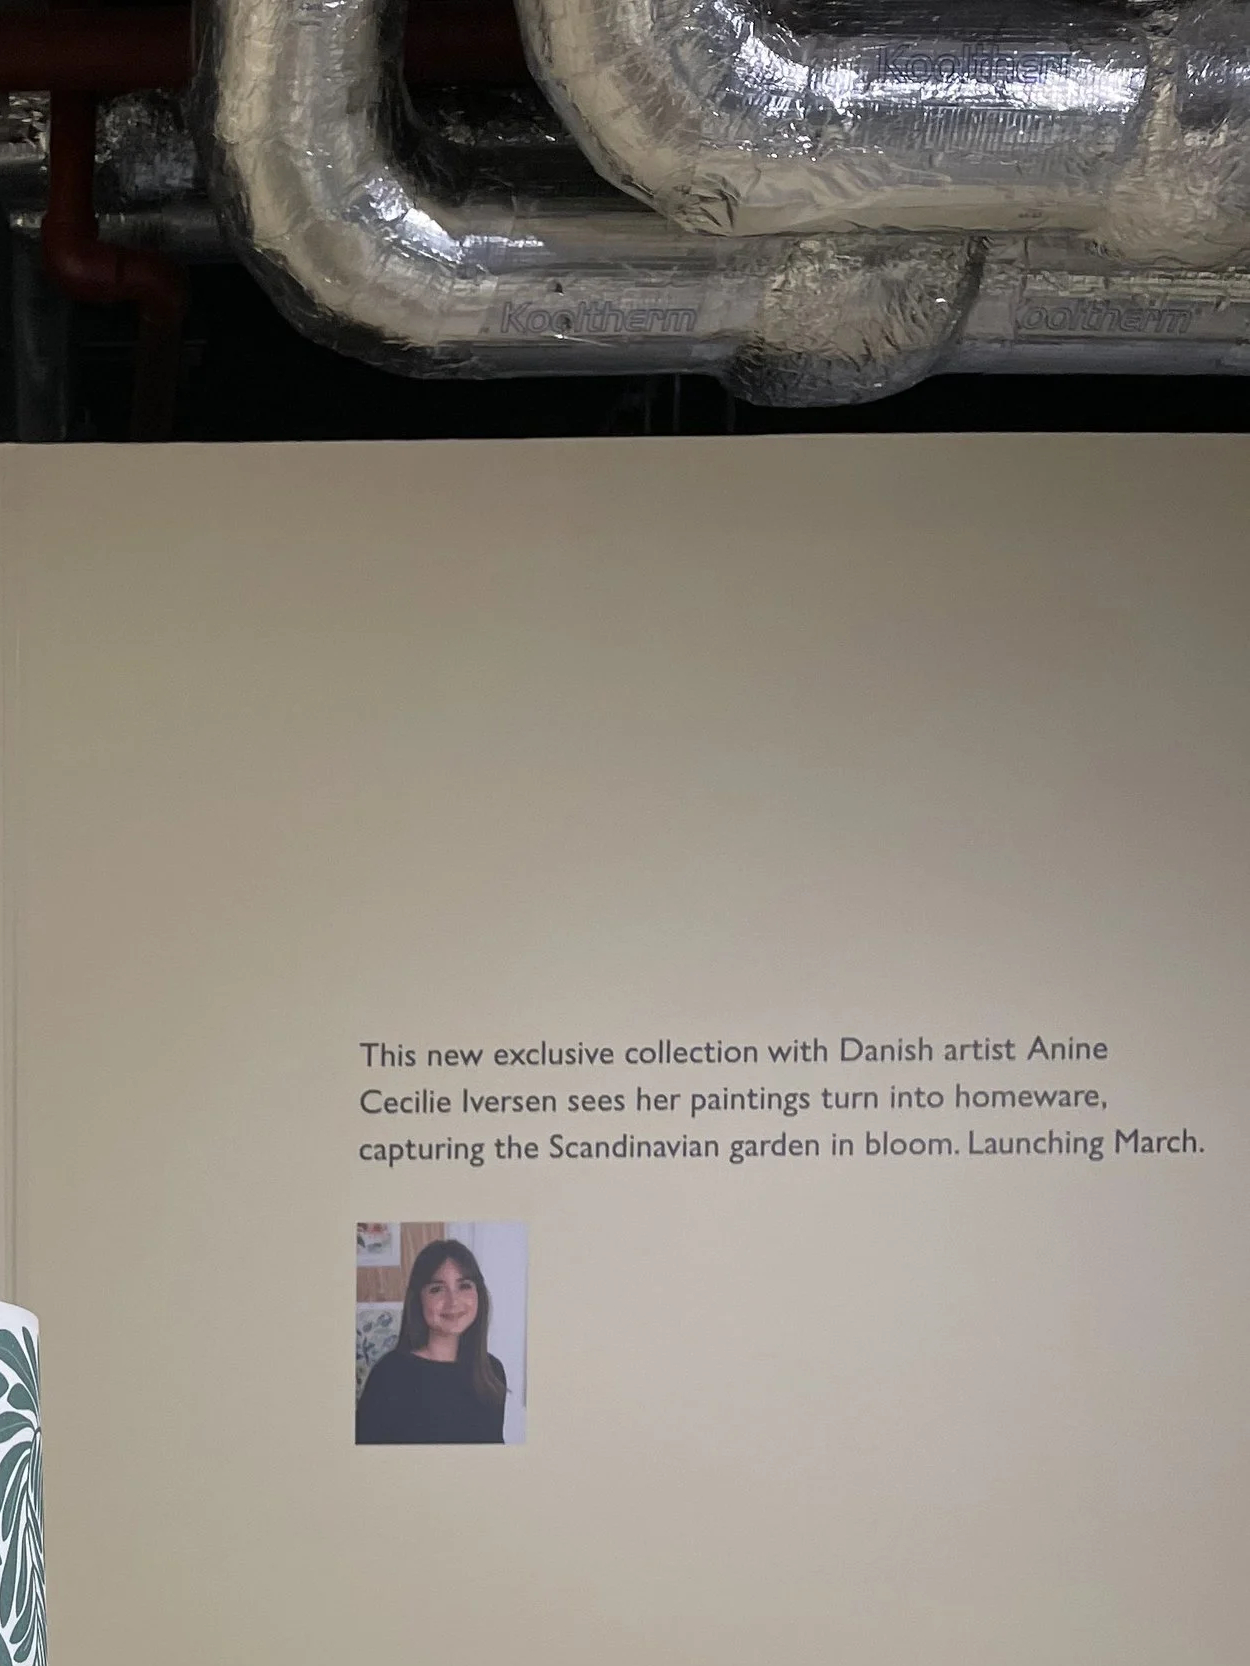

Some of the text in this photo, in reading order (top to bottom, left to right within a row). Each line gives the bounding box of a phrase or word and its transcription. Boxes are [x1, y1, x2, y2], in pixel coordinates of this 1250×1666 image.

[500, 300, 698, 334] Kooltherm
[359, 1036, 1108, 1067] This new exclusive collection with Danish artist Anine
[360, 1083, 1106, 1118] Cecilie Iversen sees her paintings turn into homeware,
[359, 1128, 1204, 1168] capturing the Scandinavian garden in bloom. Launching March.
